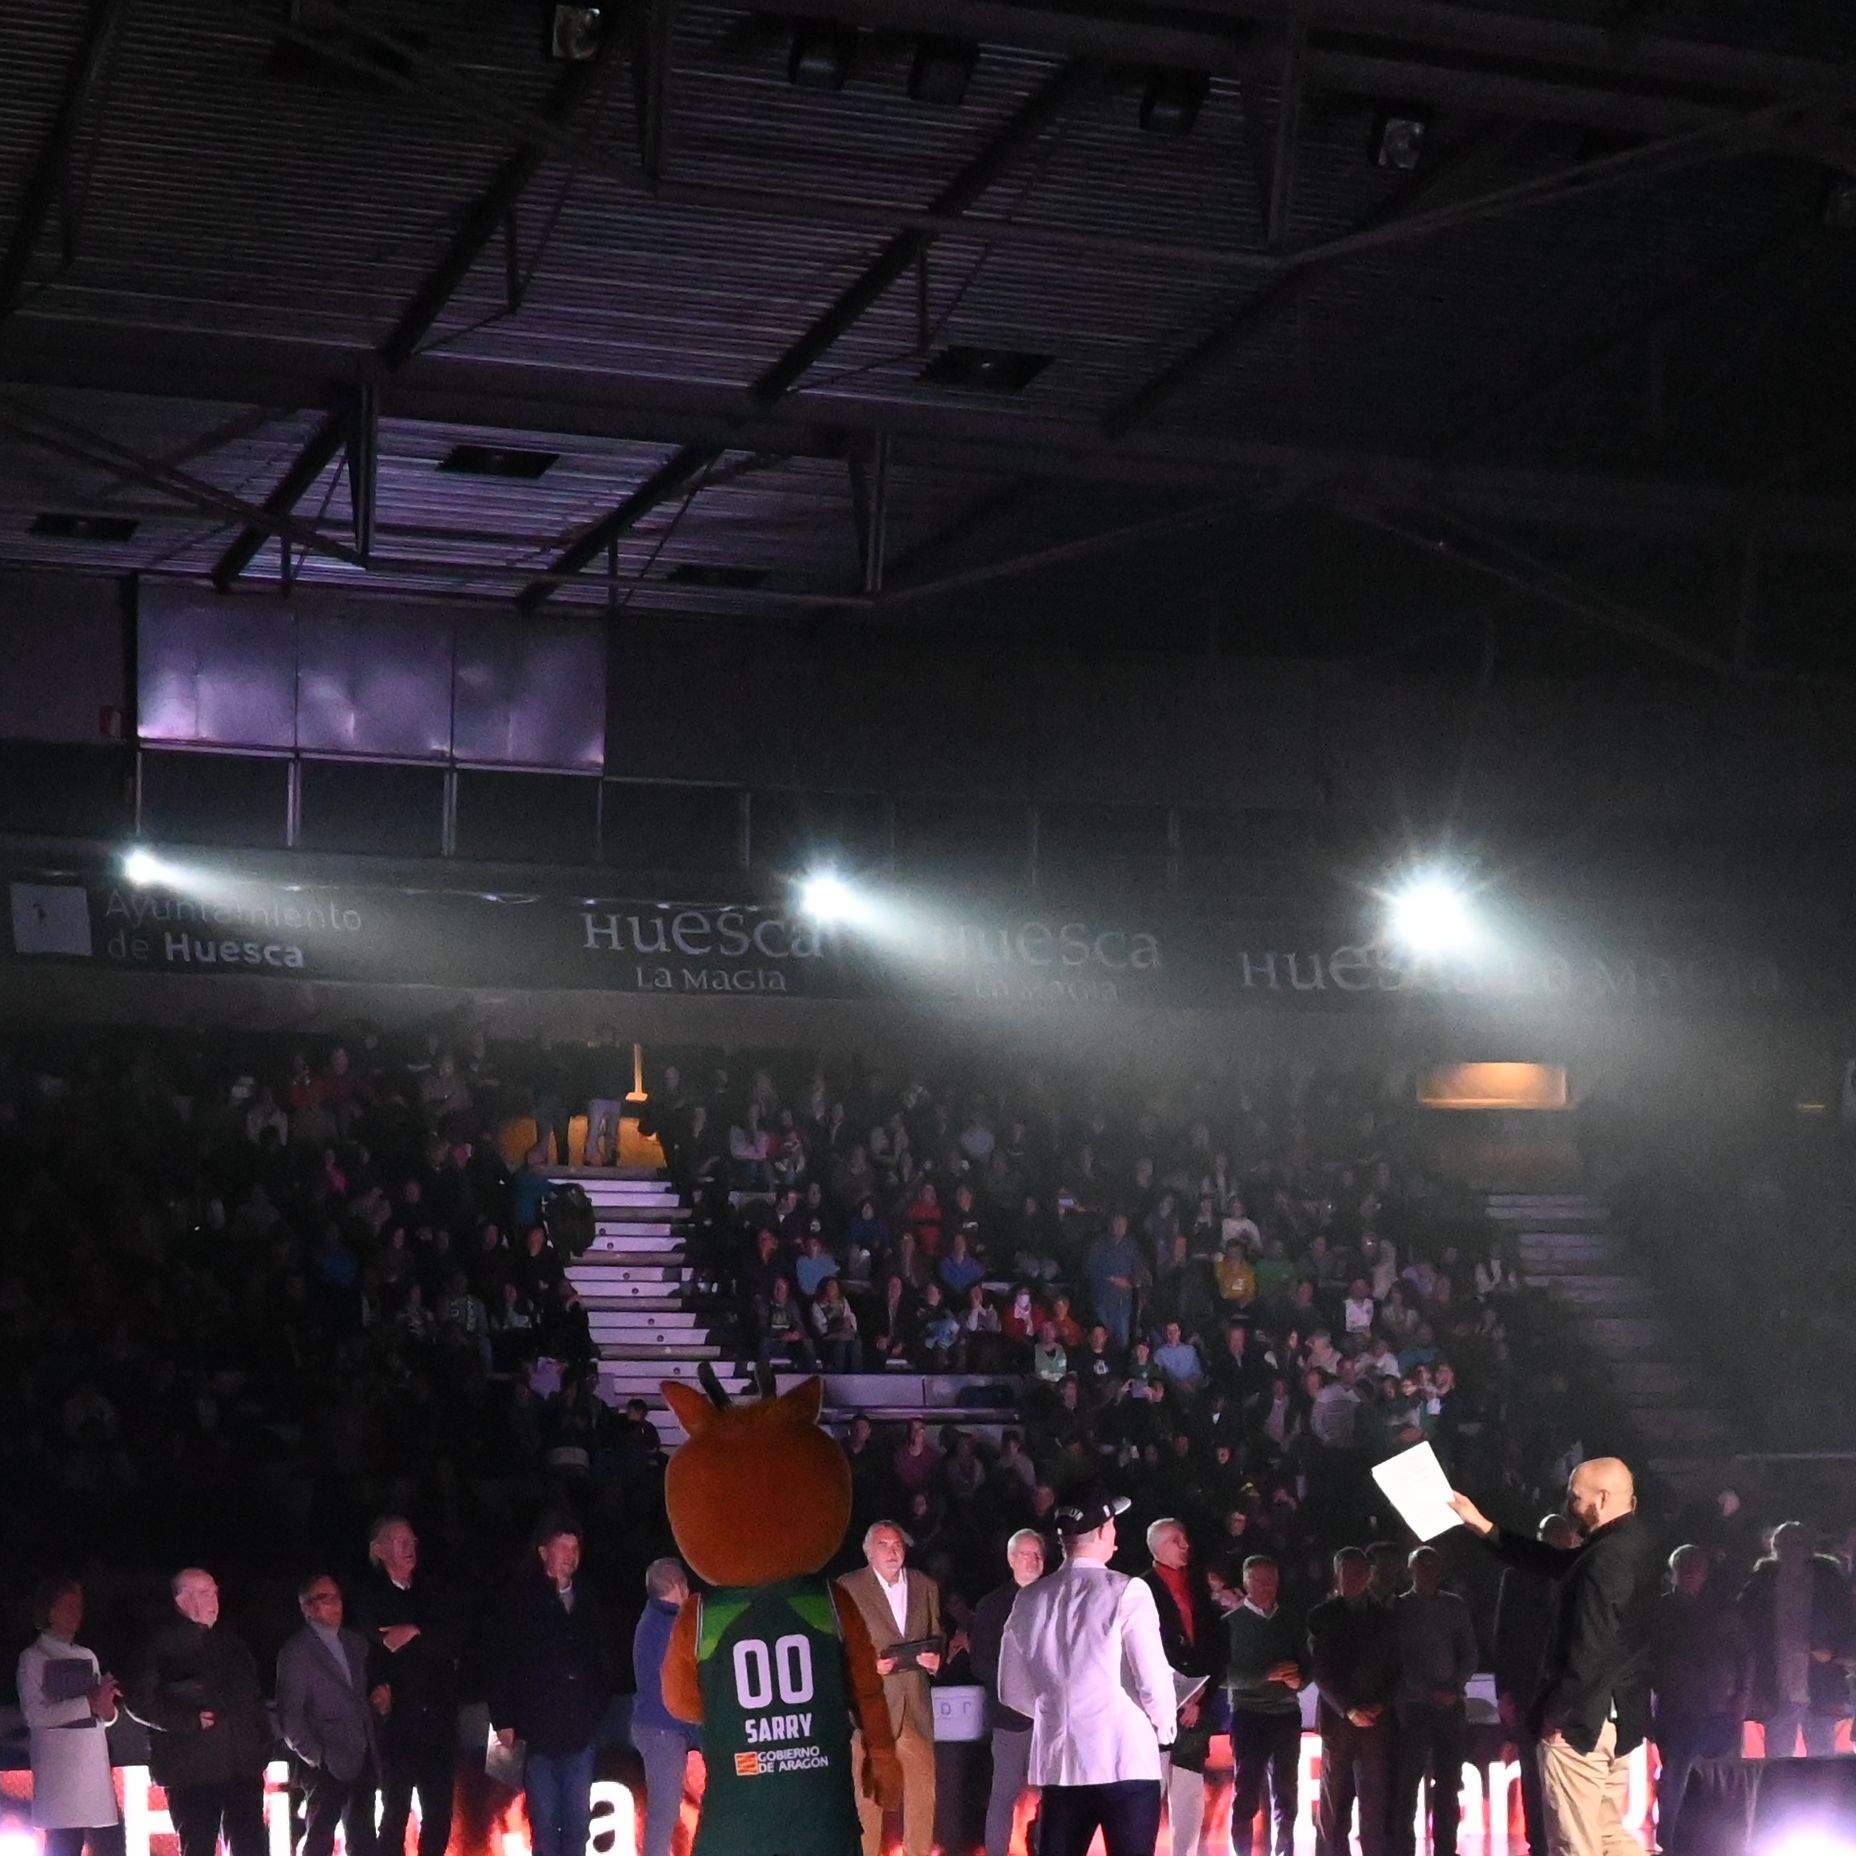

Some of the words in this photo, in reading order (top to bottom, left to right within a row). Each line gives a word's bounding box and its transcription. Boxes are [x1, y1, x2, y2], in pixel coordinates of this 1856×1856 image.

[104, 888, 363, 931] Ayuntamiento
[107, 928, 150, 960] de
[164, 930, 306, 969] Huesca
[733, 1634, 814, 1709] 00
[745, 1713, 812, 1743] SARRY
[758, 1745, 820, 1762] GOBIERNO
[759, 1762, 775, 1773] DE
